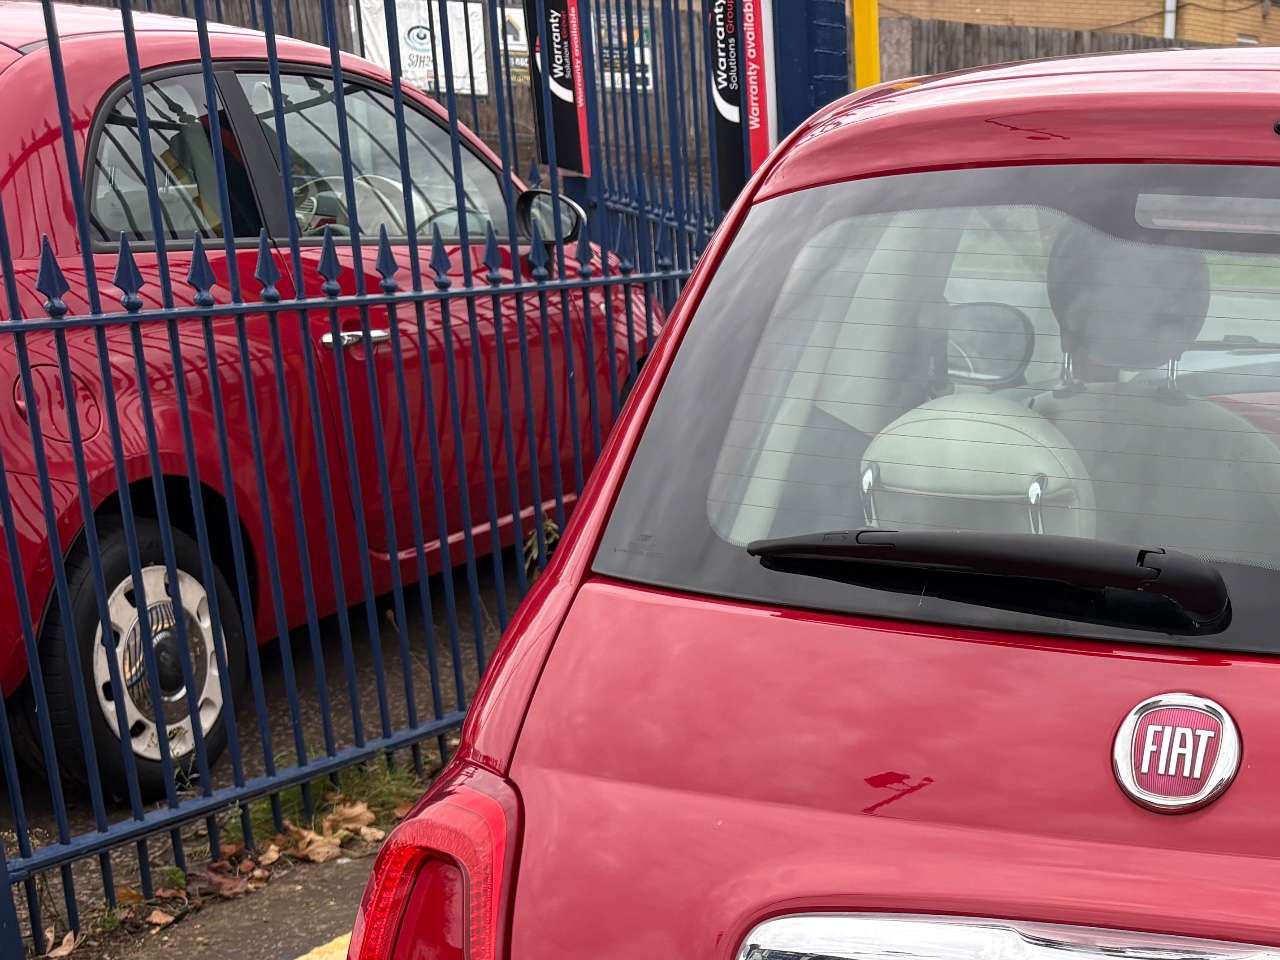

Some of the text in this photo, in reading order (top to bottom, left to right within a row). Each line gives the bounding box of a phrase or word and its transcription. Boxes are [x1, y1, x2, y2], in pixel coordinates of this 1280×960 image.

[549, 9, 562, 79] Warranty
[561, 40, 572, 80] Solutions
[569, 6, 585, 108] Warranty available
[713, 0, 728, 90] Warranty
[728, 37, 739, 90] Solutions
[743, 0, 761, 130] Warranty availabl
[1140, 724, 1216, 780] FIAT
